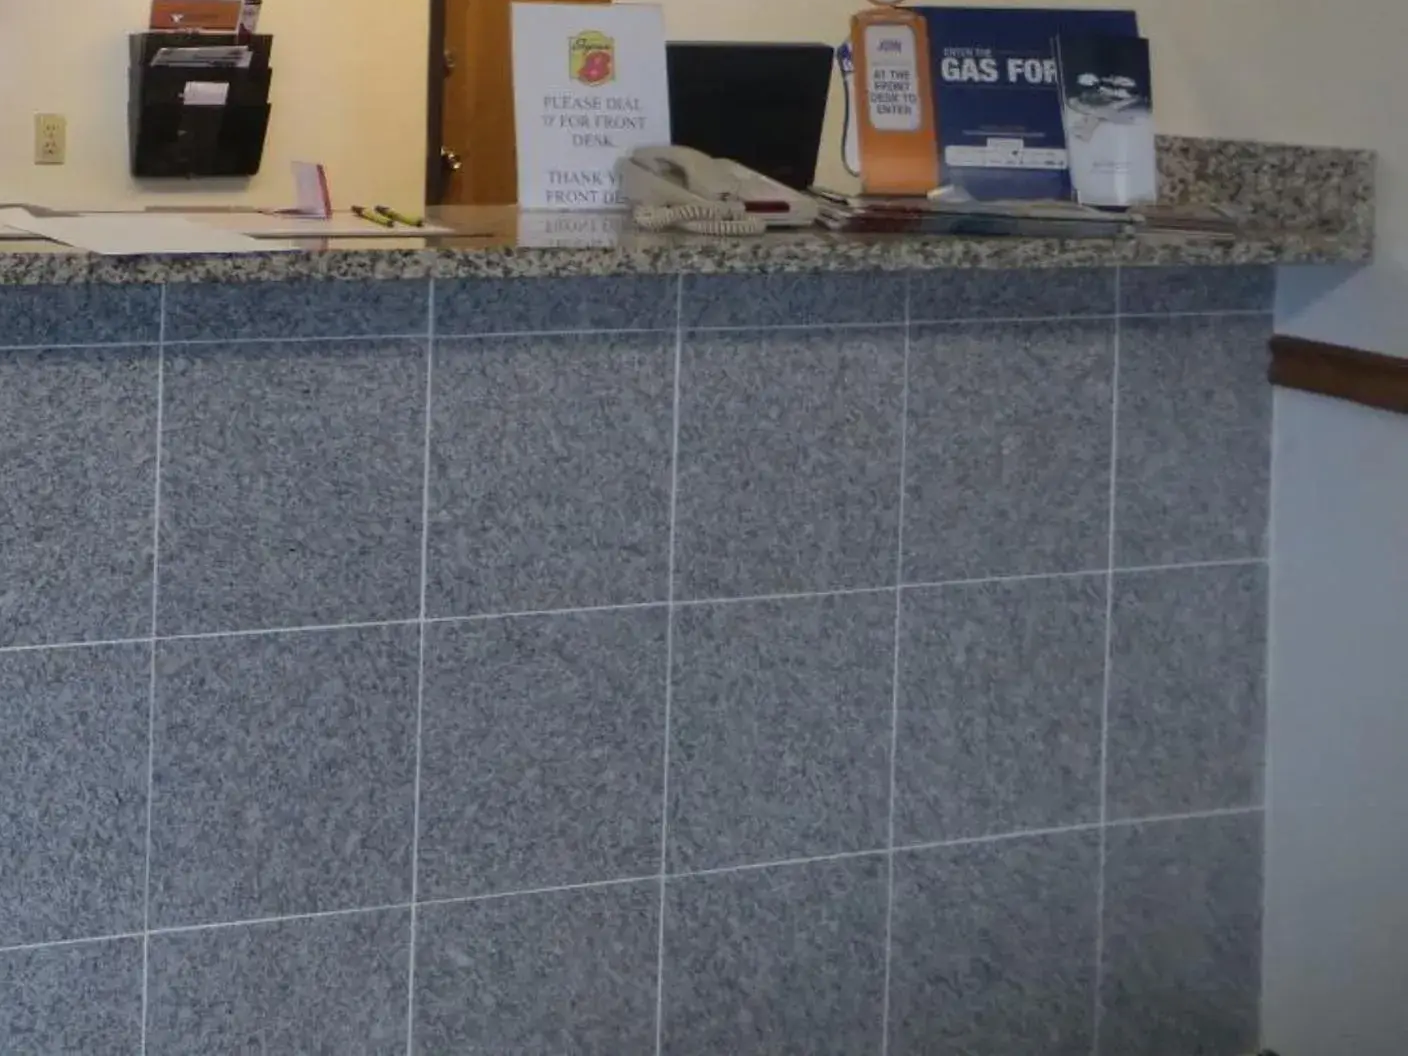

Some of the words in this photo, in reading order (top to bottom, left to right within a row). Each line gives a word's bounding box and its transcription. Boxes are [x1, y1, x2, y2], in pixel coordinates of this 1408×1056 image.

[578, 50, 611, 83] 8
[942, 58, 999, 83] GAS
[889, 69, 911, 81] THE
[874, 81, 911, 92] FRONT
[543, 95, 602, 110] PLEASE
[606, 95, 643, 111] DIAL
[871, 94, 898, 105] DESK
[901, 93, 917, 105] TO
[876, 104, 912, 116] ENTER
[560, 113, 591, 129] FOR
[594, 114, 648, 131] FRONT
[571, 132, 616, 147] DESK
[548, 170, 603, 186] THANK
[545, 189, 599, 204] FRONT
